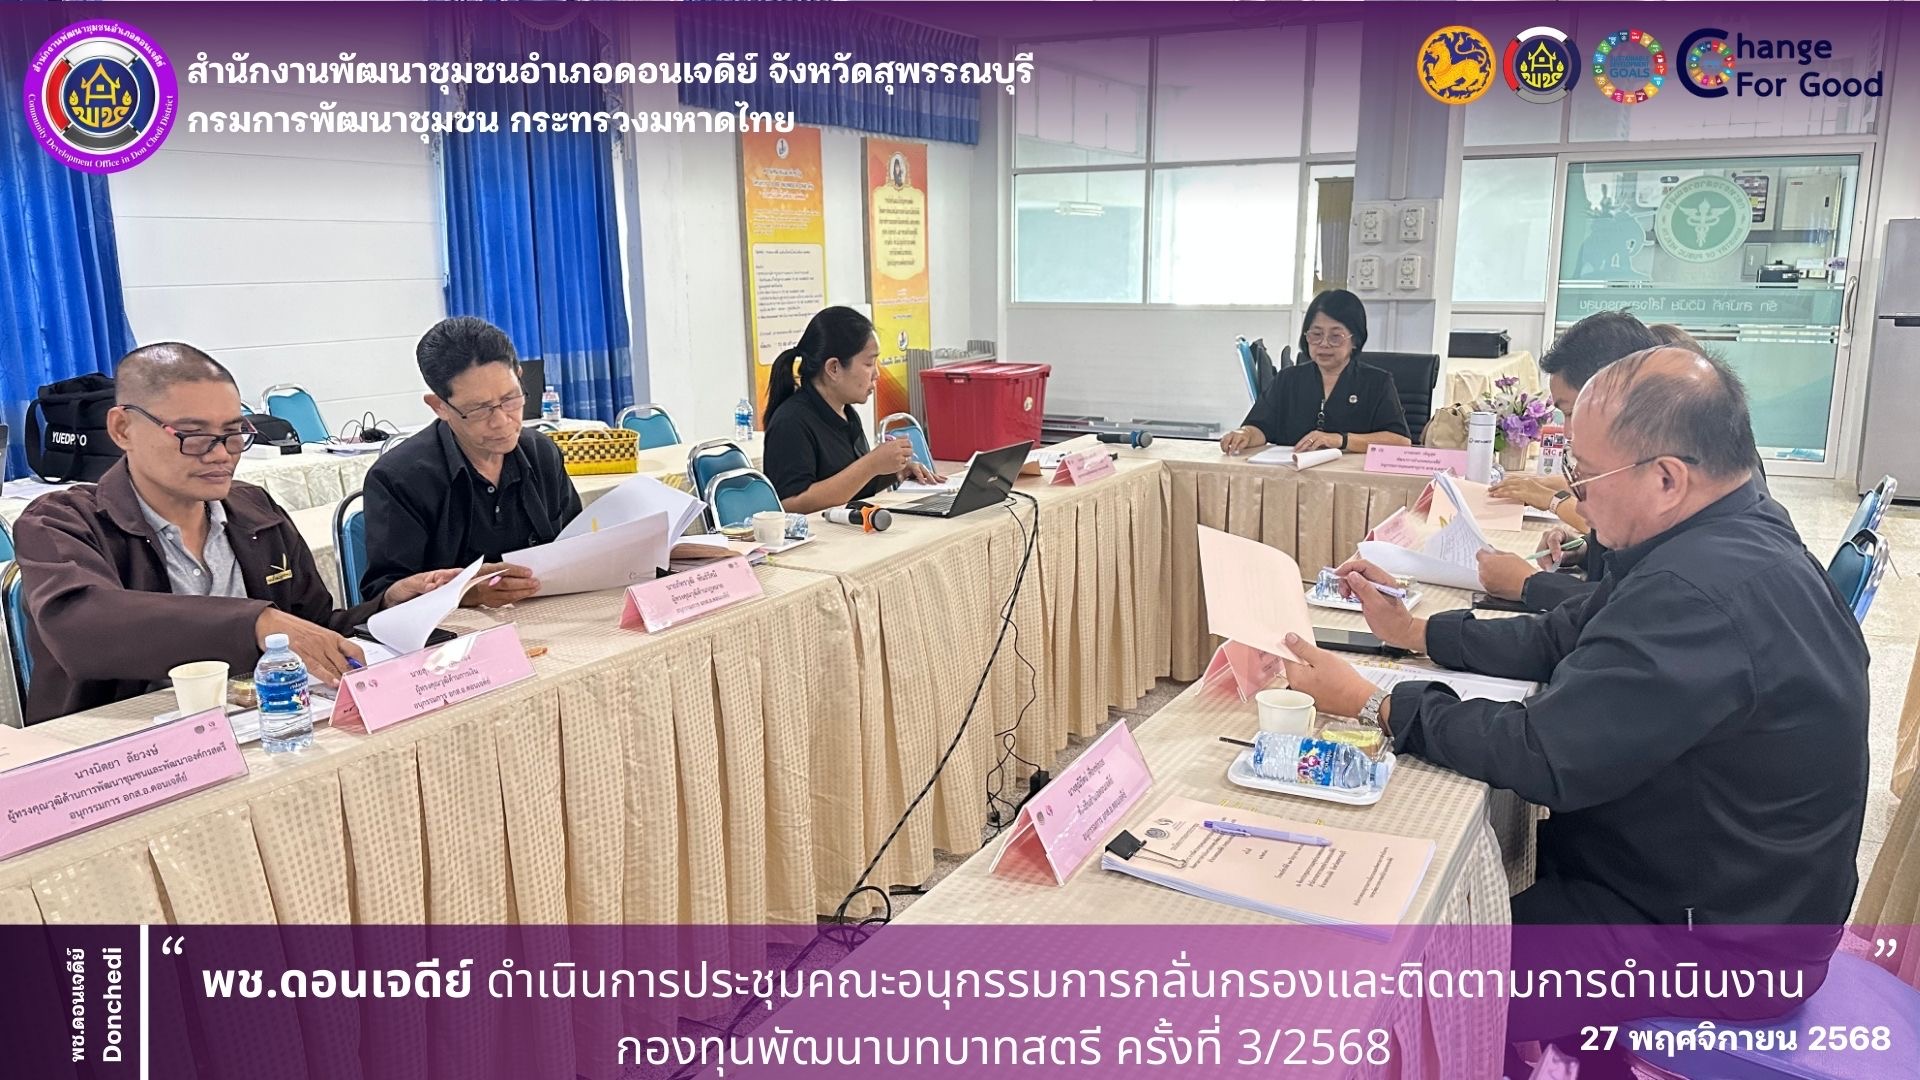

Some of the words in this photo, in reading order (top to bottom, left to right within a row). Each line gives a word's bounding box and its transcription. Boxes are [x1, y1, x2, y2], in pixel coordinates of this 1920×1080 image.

[7, 741, 227, 824] ผู้ทรงคุณวุฒิด้านการพัฒนาชุมชนและพัฒนาองค์กรสตรี
[74, 758, 121, 780] นางนิตยา
[68, 797, 121, 820] อนุกรรมการ
[122, 772, 188, 802] อกส.อ.ดอนเจดีย์
